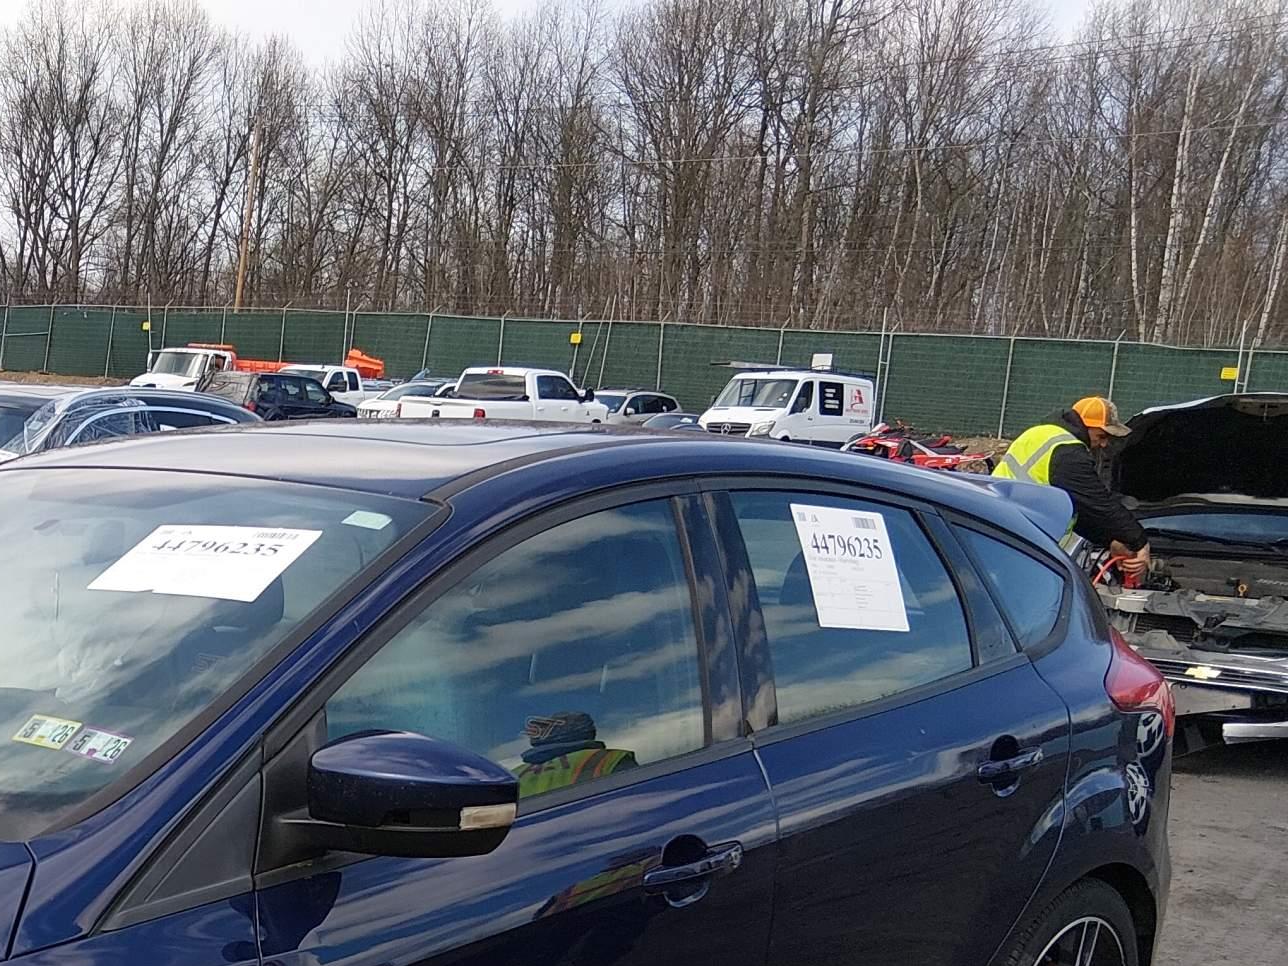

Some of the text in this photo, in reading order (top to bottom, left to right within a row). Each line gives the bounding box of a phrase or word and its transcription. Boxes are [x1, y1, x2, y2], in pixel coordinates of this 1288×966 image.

[151, 539, 285, 557] 44796235
[811, 531, 883, 560] 44796235
[73, 734, 90, 752] 5
